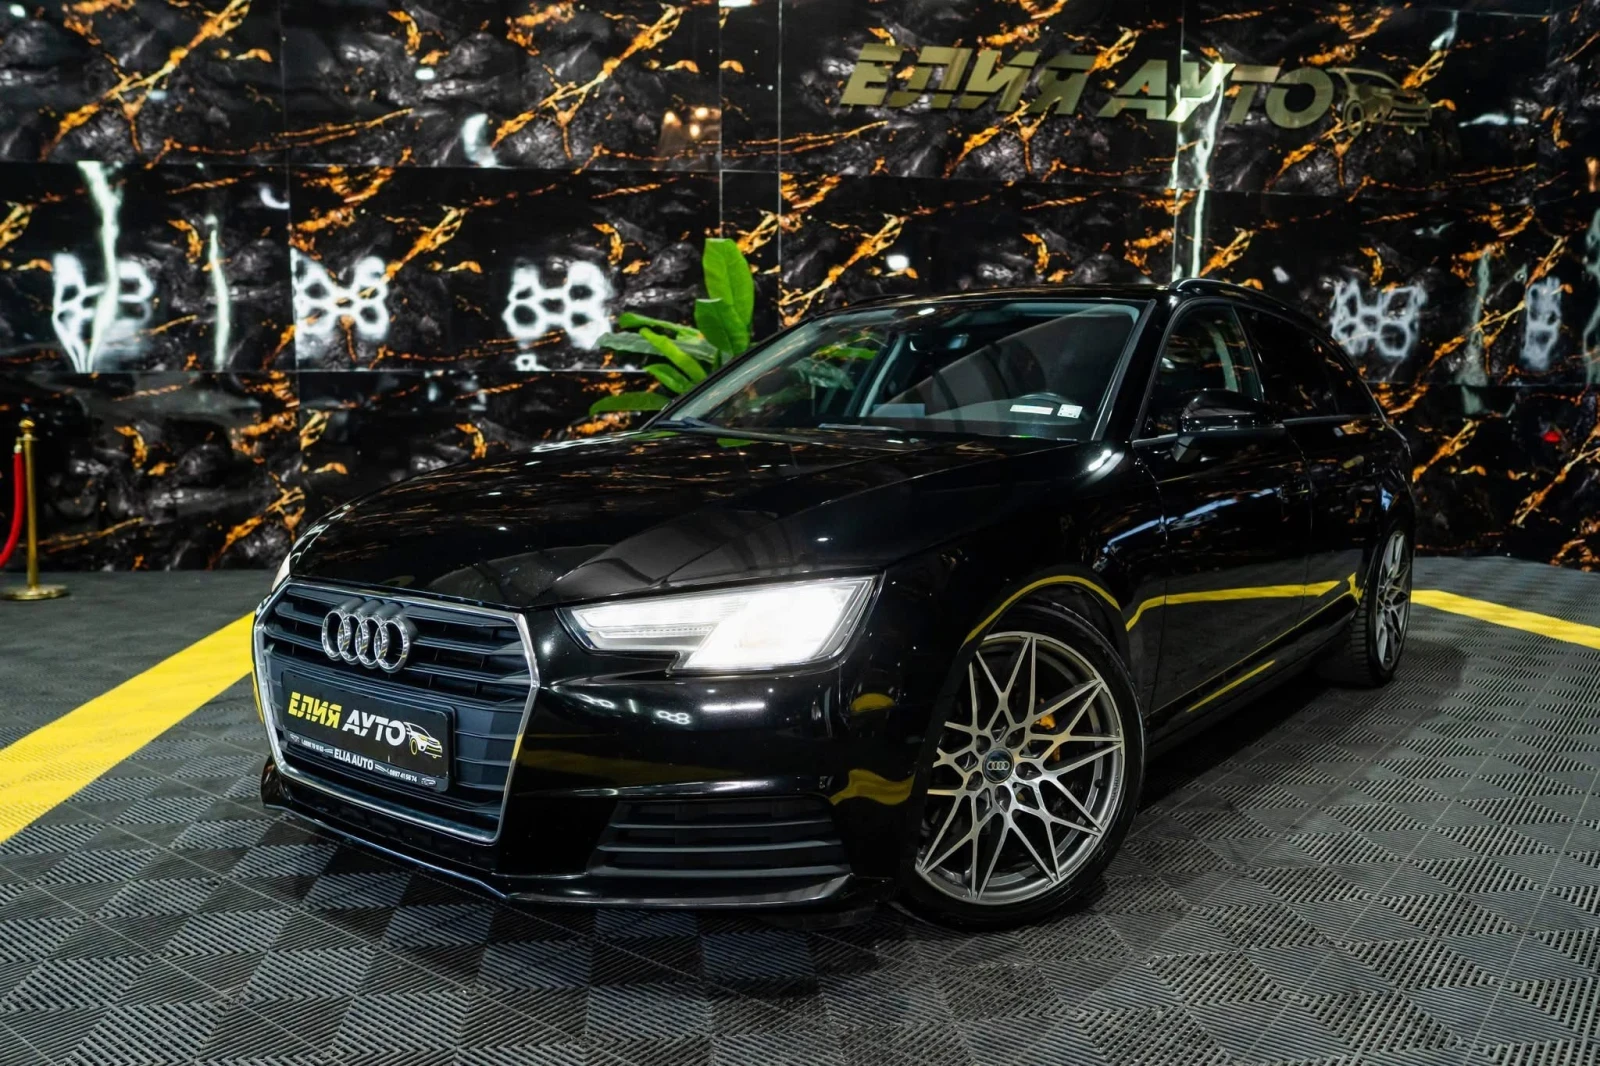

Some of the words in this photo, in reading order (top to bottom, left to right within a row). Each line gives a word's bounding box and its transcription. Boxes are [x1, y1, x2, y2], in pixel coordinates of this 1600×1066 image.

[840, 43, 1098, 116] ЕЛИЯ
[288, 691, 342, 729] ЕЛИЯ
[334, 748, 351, 763] ELIA
[351, 756, 374, 771] AUTO
